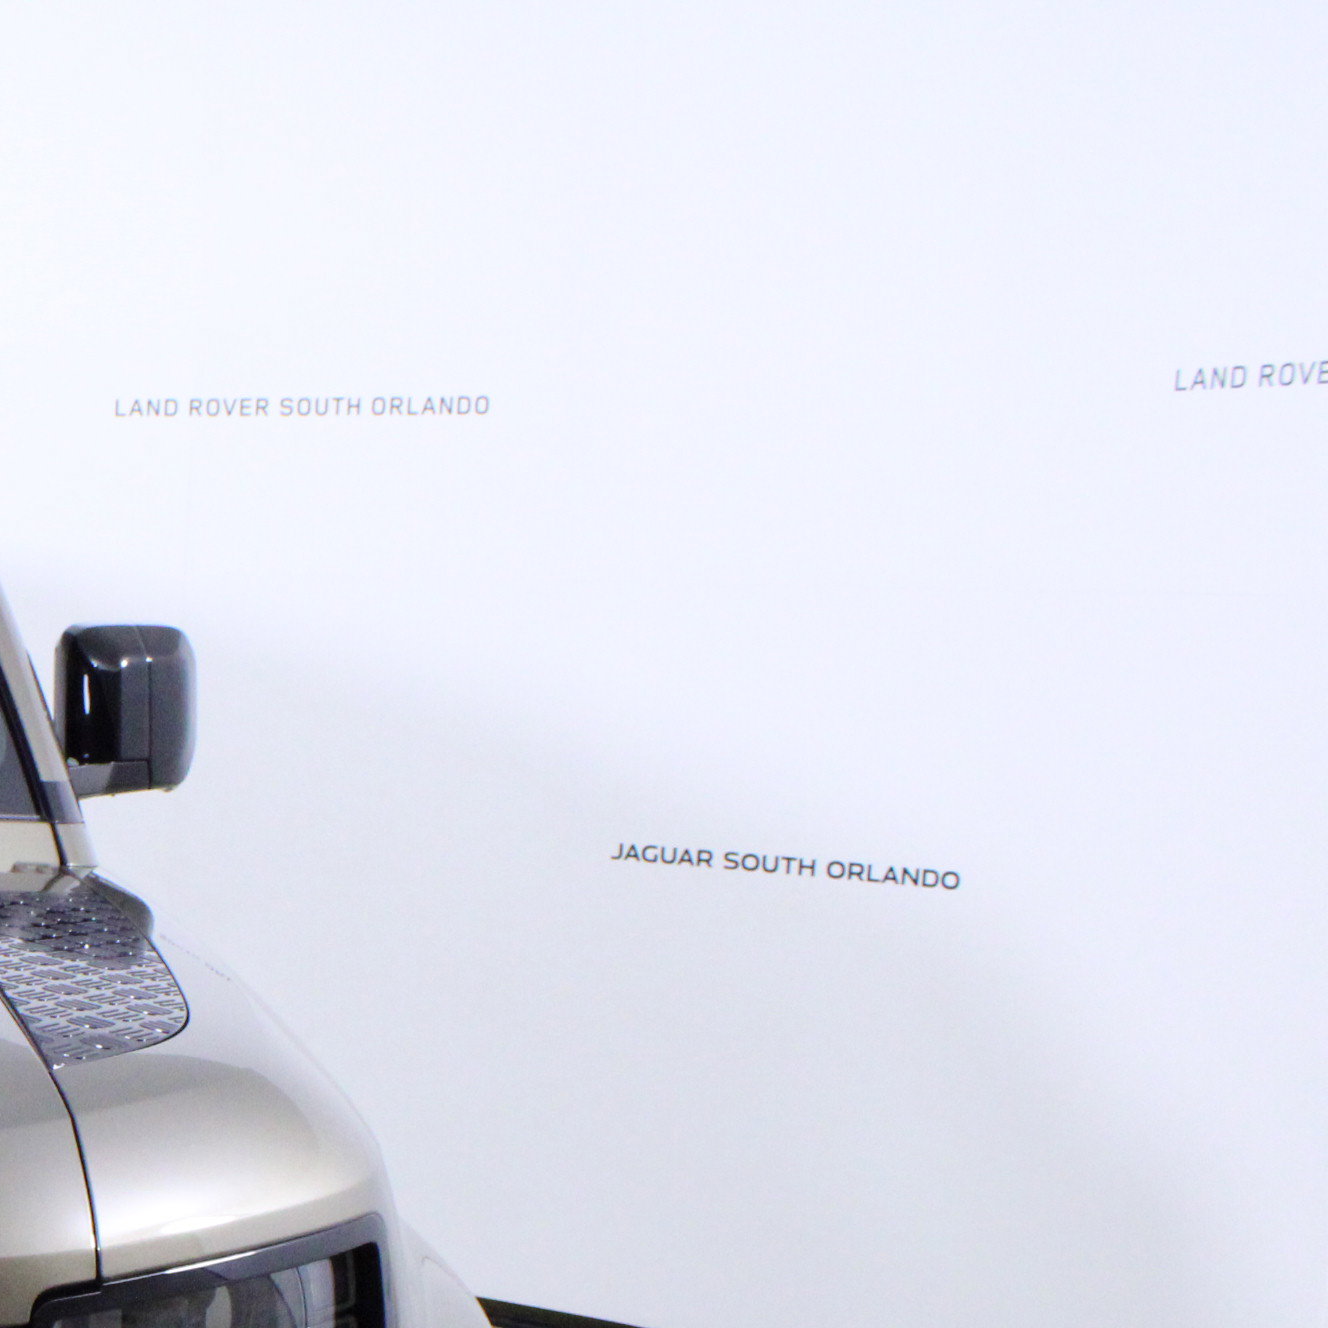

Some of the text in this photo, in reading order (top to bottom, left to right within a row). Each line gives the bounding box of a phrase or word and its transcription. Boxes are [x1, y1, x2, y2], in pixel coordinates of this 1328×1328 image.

[1174, 365, 1247, 392] LAND
[113, 395, 491, 418] LAND ROVER SOUTH ORLANDO
[609, 843, 962, 891] JAGUAR SOUTH ORLANDO
